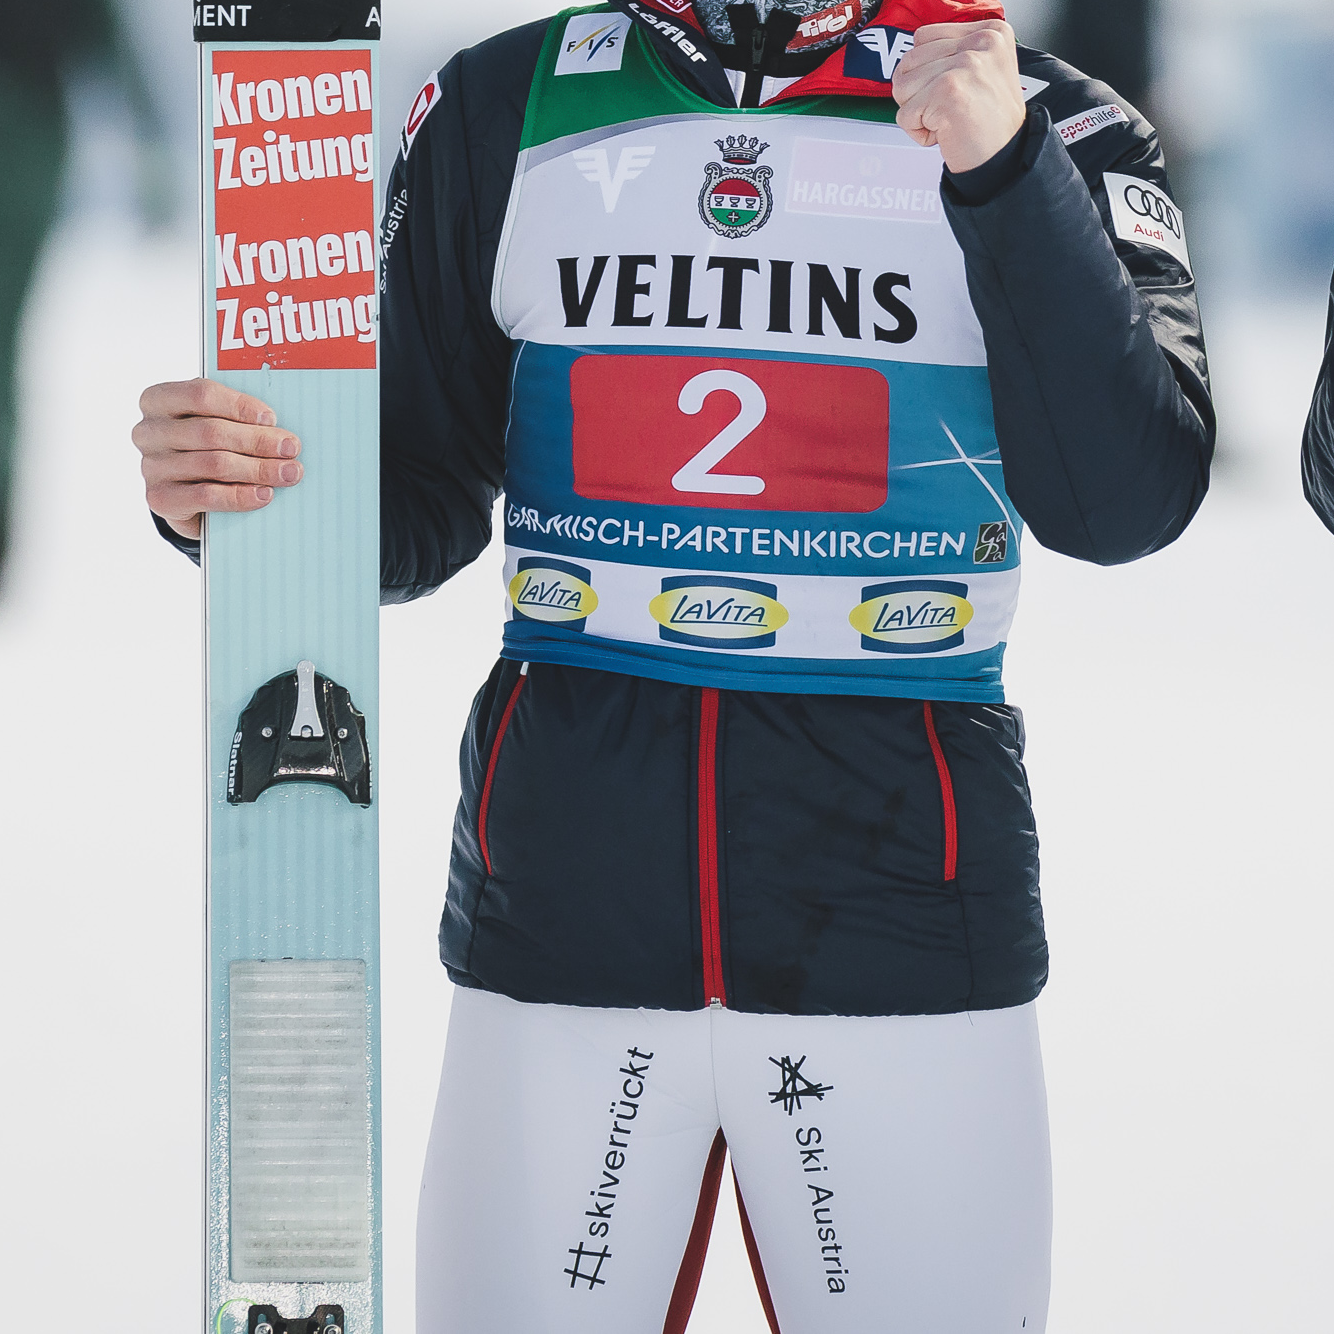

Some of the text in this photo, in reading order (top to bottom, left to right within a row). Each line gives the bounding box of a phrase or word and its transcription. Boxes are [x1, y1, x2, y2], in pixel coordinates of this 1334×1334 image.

[566, 37, 619, 52] FIS
[796, 5, 854, 38] Tirol
[211, 67, 373, 128] Kronen
[1060, 109, 1117, 139] sporthilfe
[215, 130, 375, 190] Zeitung
[792, 180, 939, 213] HARGASSNER
[215, 228, 376, 288] Kronen
[1133, 223, 1165, 242] Audi
[216, 291, 378, 351] Zeitung
[556, 254, 919, 345] VELTINS
[671, 369, 767, 495] 2
[507, 503, 966, 558] GARMISCH-PARTENKIRCHEN
[228, 731, 244, 796] Slatnar
[563, 1046, 654, 1291] #skiverrückt
[795, 1126, 849, 1294] Ski Austria
